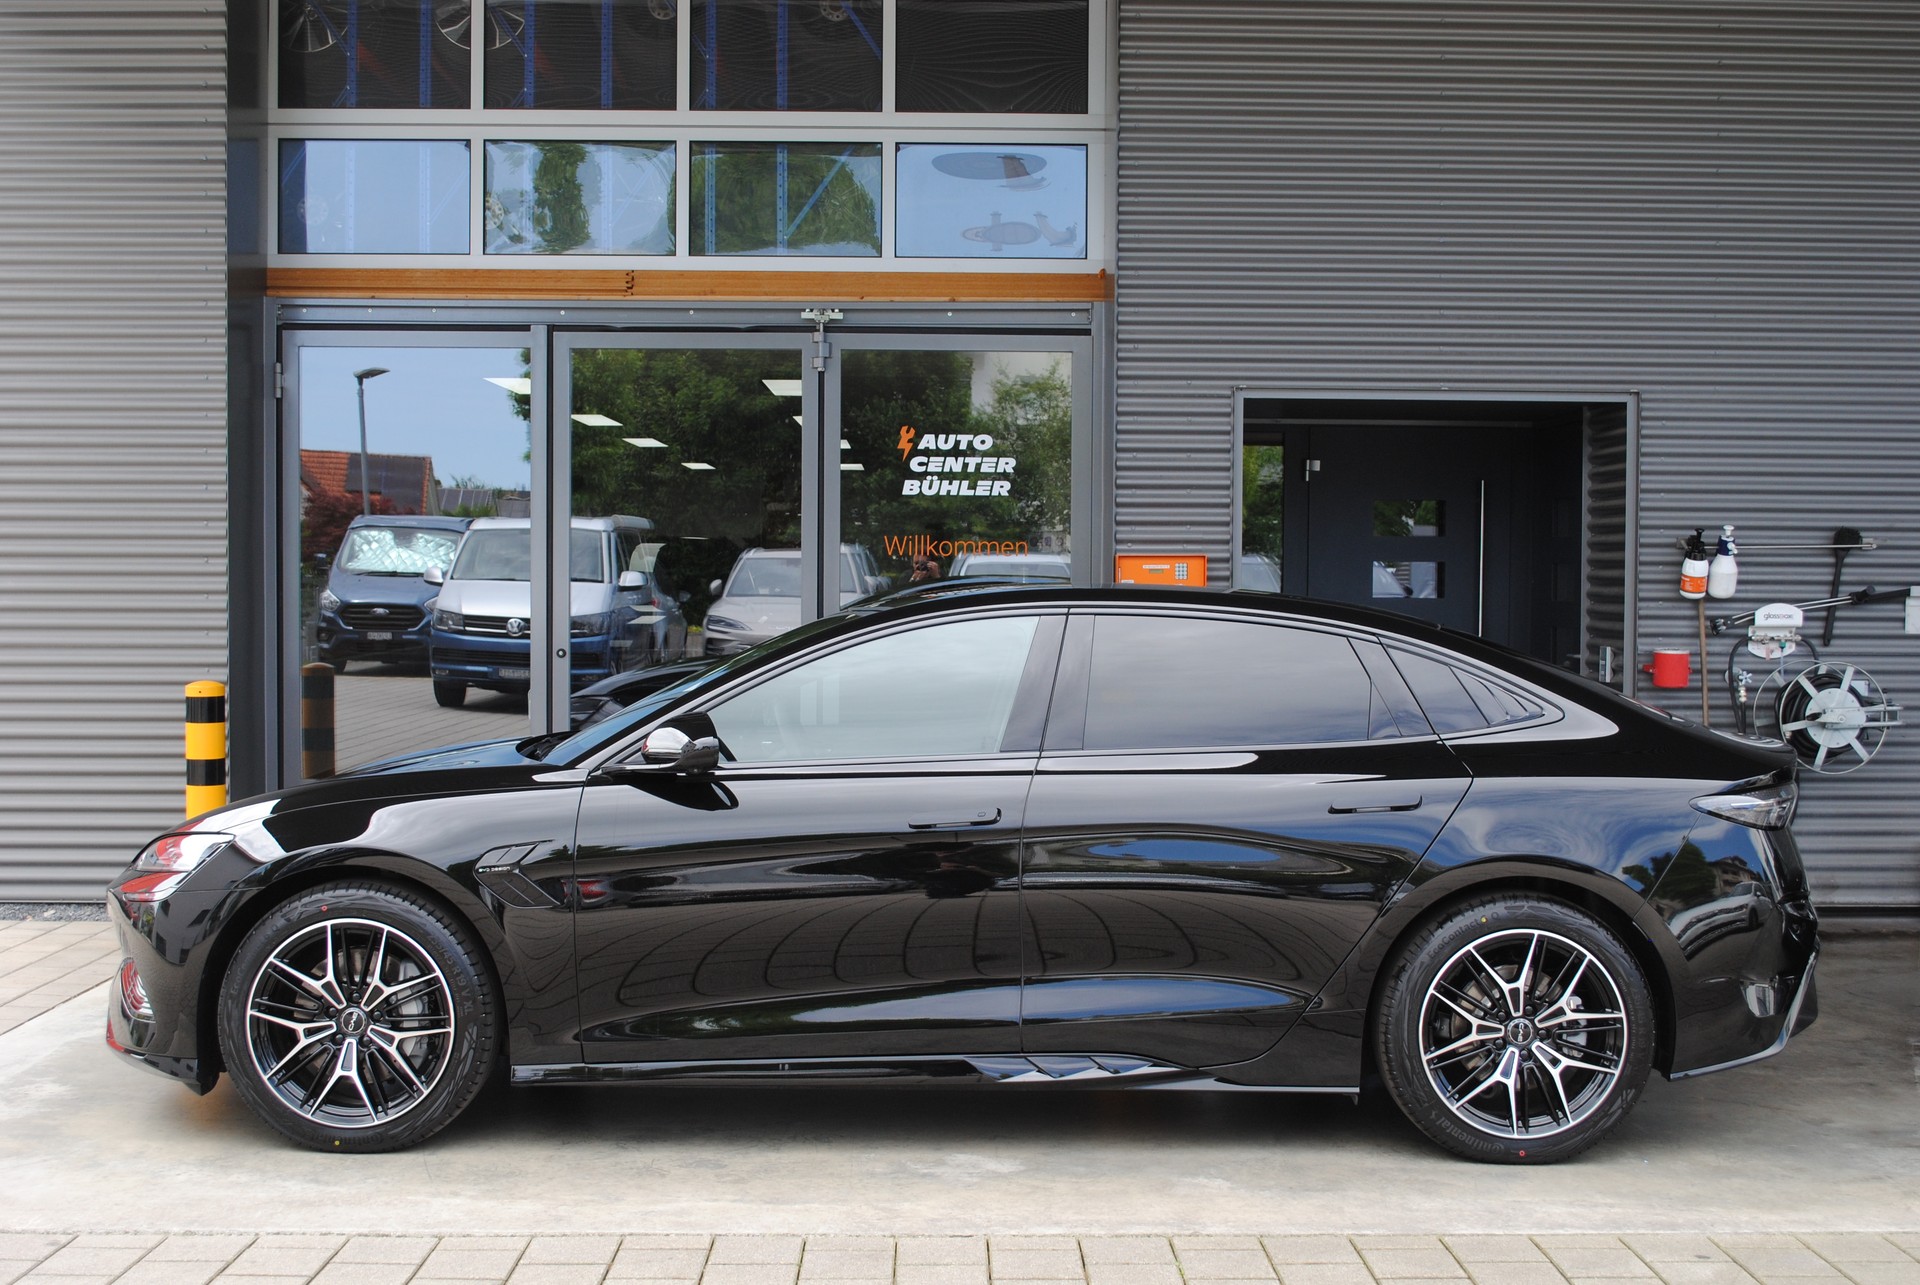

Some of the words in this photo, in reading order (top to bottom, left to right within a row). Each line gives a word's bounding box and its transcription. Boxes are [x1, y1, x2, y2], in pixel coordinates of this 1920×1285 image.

[916, 433, 994, 450] AUTO
[909, 456, 1017, 473] CENTER
[901, 475, 1012, 496] BÜHLER
[883, 535, 1029, 557] Willkommen
[1427, 918, 1480, 959] EcoContact
[1435, 1116, 1505, 1155] Continental
